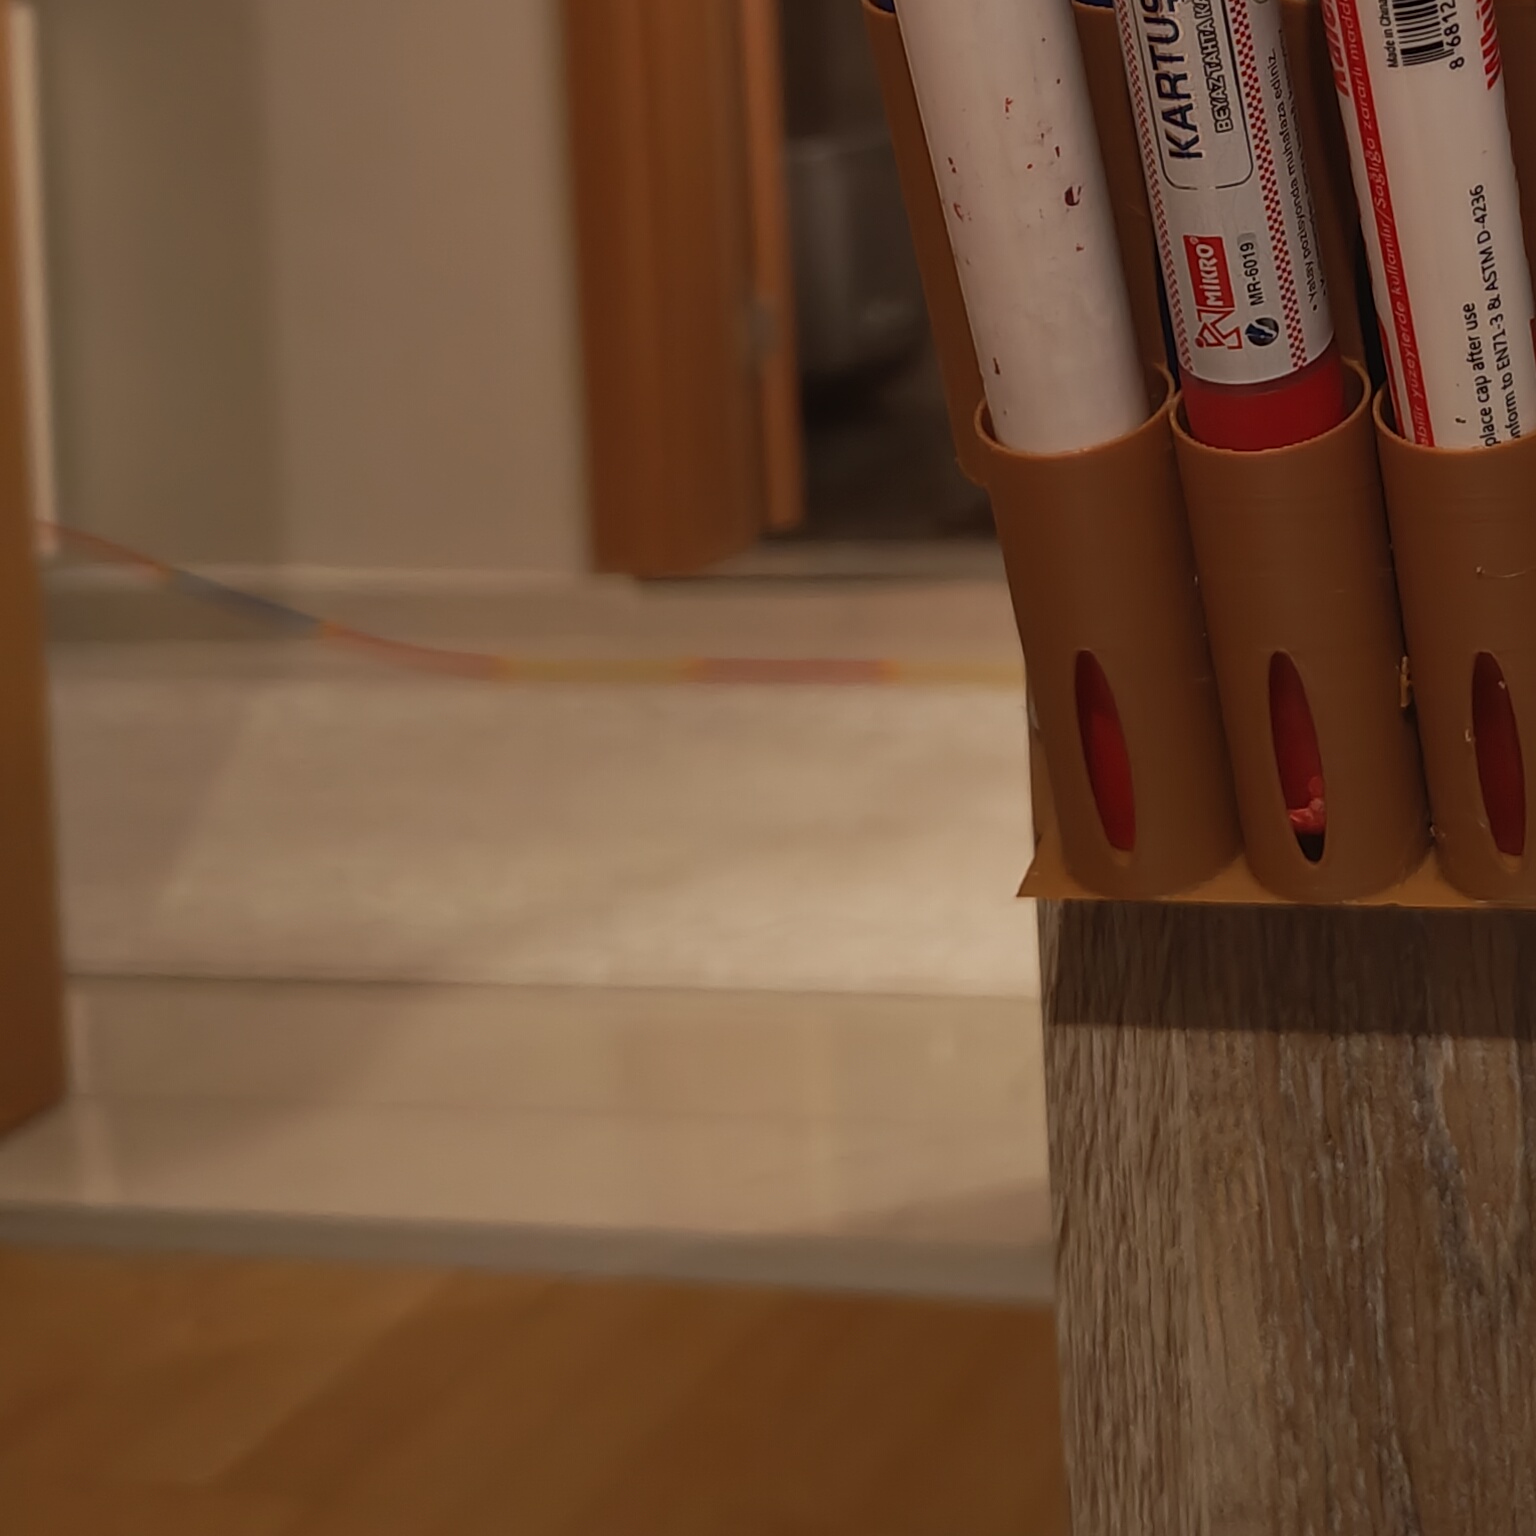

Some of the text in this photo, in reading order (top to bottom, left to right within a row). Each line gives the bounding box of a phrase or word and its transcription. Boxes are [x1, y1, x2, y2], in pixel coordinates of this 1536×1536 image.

[1197, 16, 1221, 75] TAHTA
[1447, 55, 1465, 69] 8
[1206, 71, 1233, 134] BEYAZ
[1351, 65, 1373, 132] zararlı
[1272, 100, 1297, 177] muhafaza
[1469, 183, 1490, 242] D-4236
[1238, 239, 1265, 306] MR-6019
[1479, 246, 1498, 290] ASTM
[1462, 301, 1478, 329] use
[1486, 294, 1501, 309] &
[1464, 333, 1484, 370] after
[1489, 312, 1510, 369] EN71-3
[1476, 374, 1494, 402] cap
[1500, 371, 1514, 389] to
